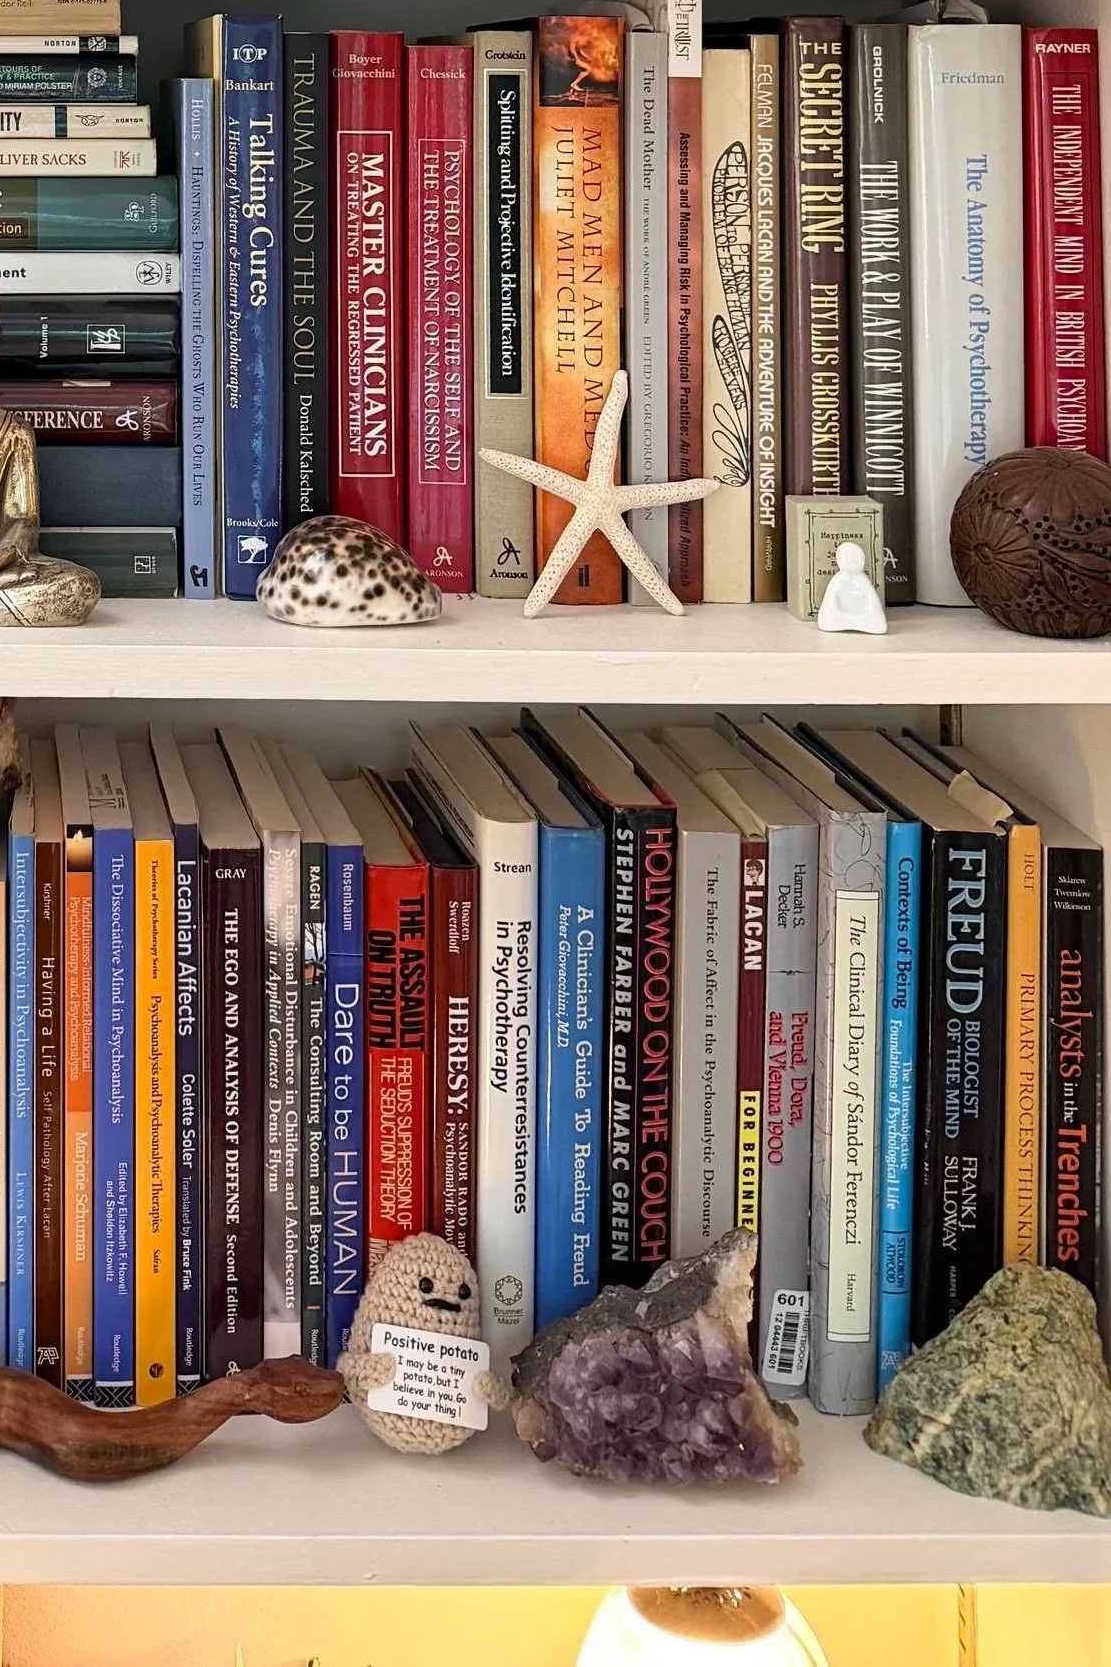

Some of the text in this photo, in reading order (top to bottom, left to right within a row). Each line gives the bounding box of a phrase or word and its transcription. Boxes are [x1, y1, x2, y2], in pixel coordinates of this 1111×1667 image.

[800, 42, 842, 56] THE
[1035, 43, 1090, 54] RAYNER
[348, 53, 382, 67] Boyer
[941, 72, 1005, 85] Friedman
[225, 80, 274, 93] Bankart
[43, 153, 86, 166] SACKS
[241, 114, 275, 308] Talking Cures
[361, 153, 388, 457] MASTER CLINICIANS
[215, 868, 247, 881] GRAY
[494, 861, 532, 874] Strean
[342, 863, 354, 932] Rosenbaum
[743, 890, 763, 971] LACAN
[945, 848, 987, 1014] FREUD
[333, 983, 360, 1297] Dare to be HUMAN
[778, 1294, 804, 1306] 601
[384, 1332, 478, 1361] Positive potato
[398, 1355, 403, 1365] I
[406, 1359, 424, 1371] may
[428, 1361, 438, 1371] be
[450, 1366, 465, 1378] tiny
